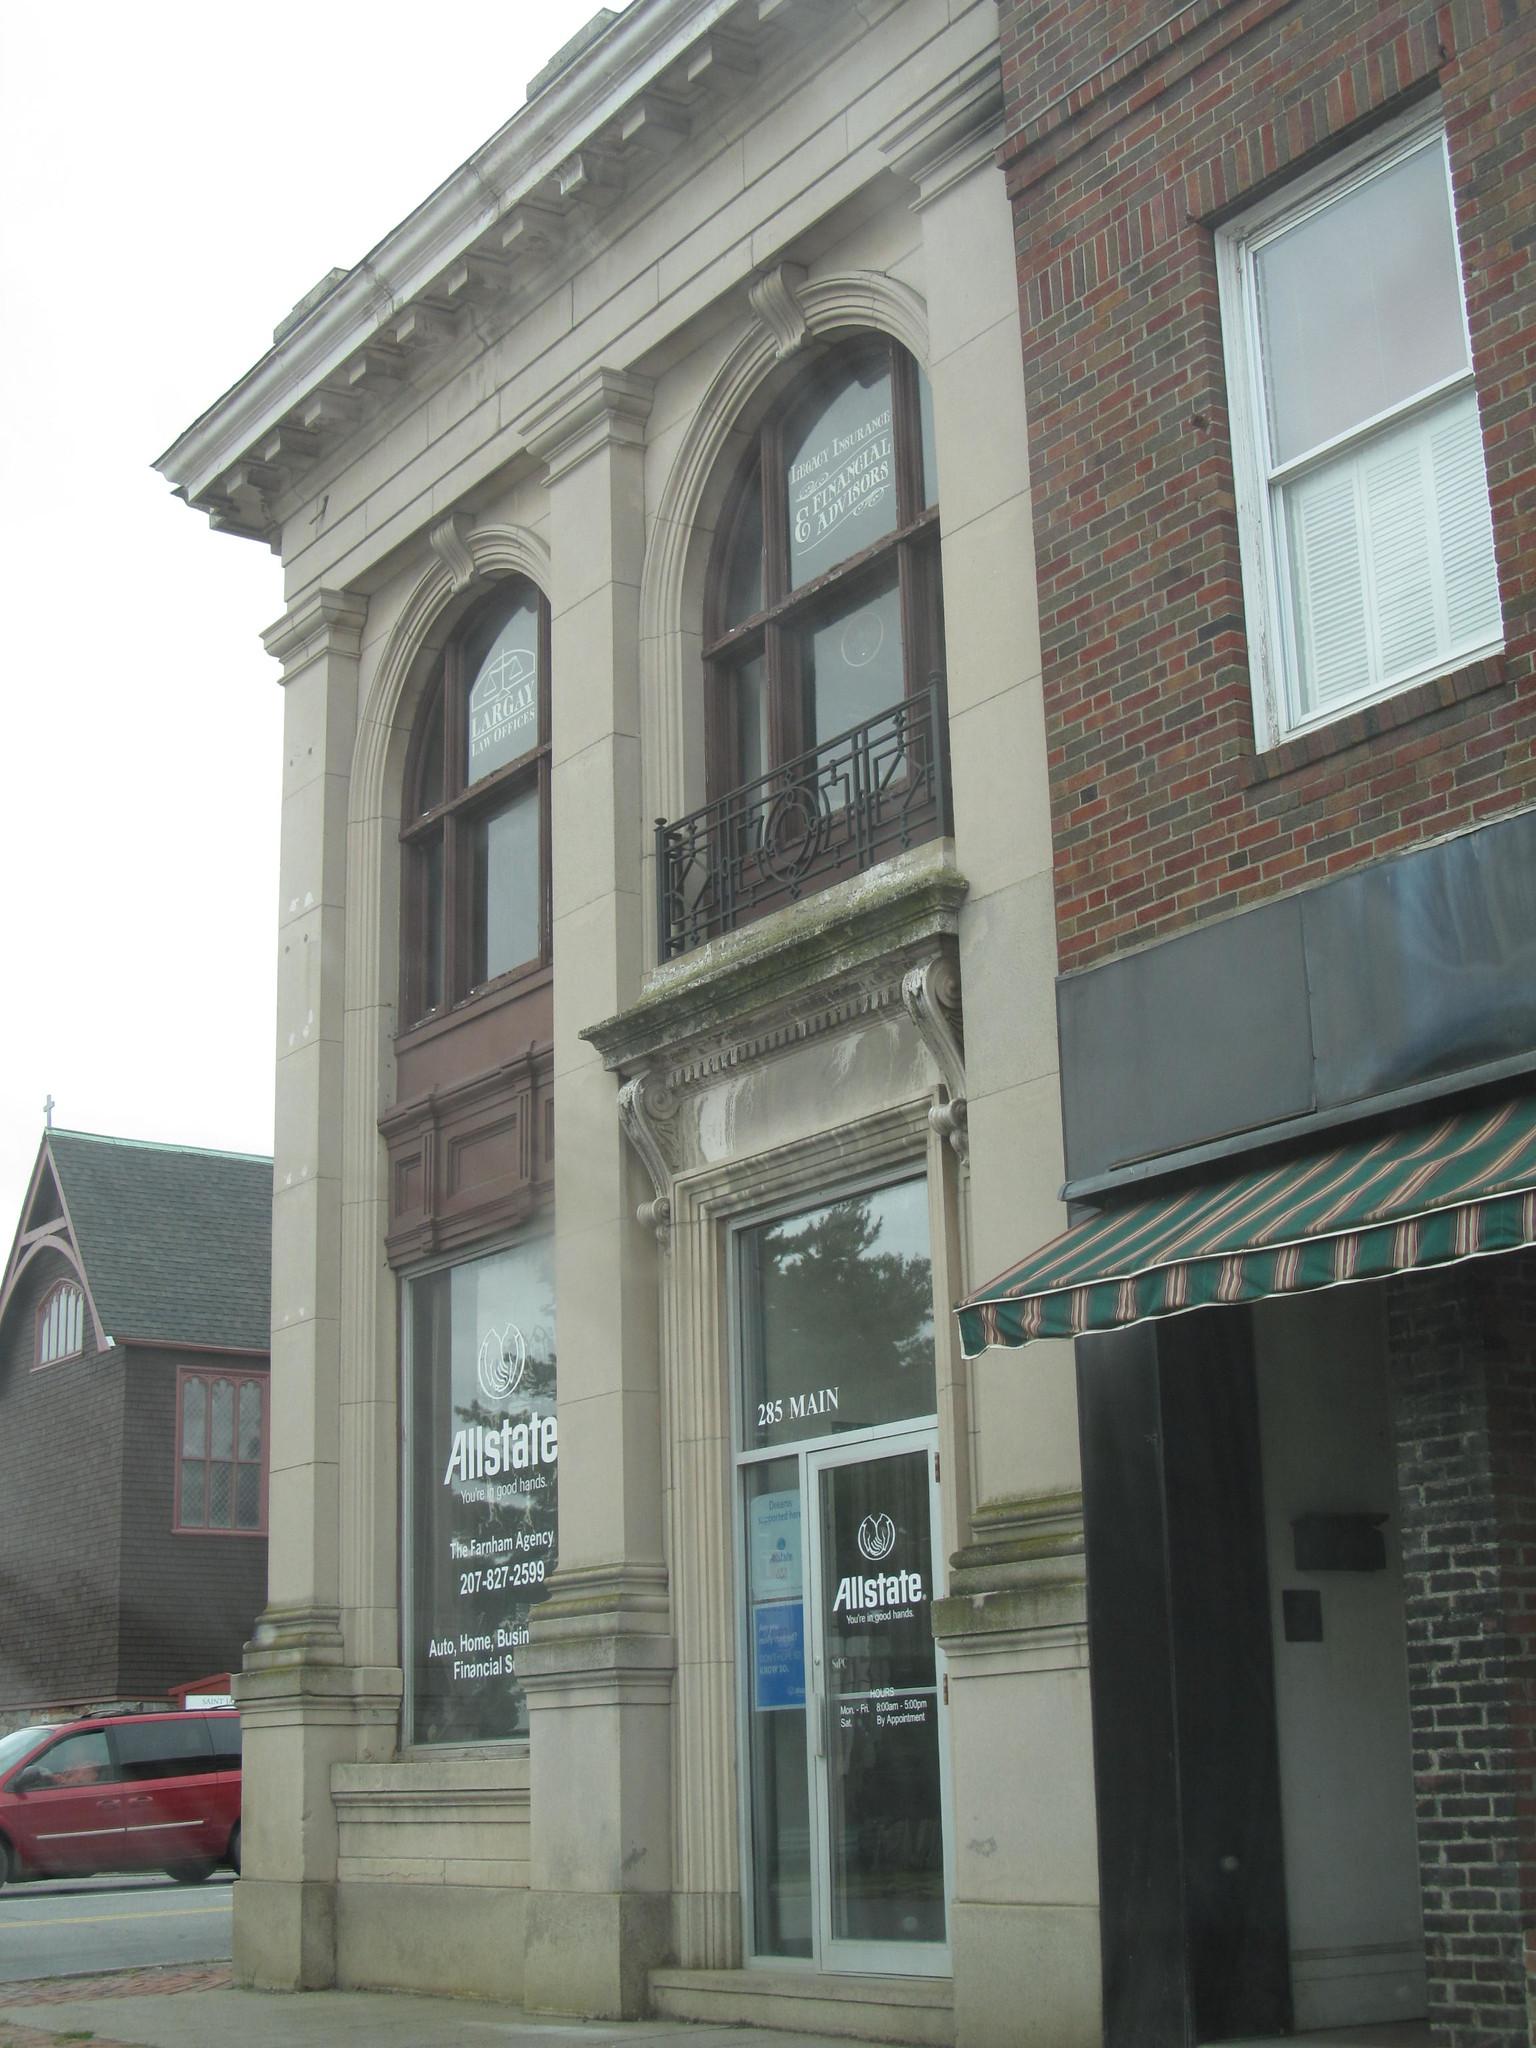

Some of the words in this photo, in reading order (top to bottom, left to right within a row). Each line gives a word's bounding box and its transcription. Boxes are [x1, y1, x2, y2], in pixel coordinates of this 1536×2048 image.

[791, 449, 829, 483] LEGACY
[831, 410, 891, 457] INSURANCE
[813, 438, 891, 515] FINANCIAL
[817, 460, 889, 535] ADVISORS
[471, 679, 535, 739] LARGAY
[472, 737, 491, 757] LAW
[493, 708, 535, 743] OFFICES
[757, 1399, 783, 1427] 285
[789, 1386, 839, 1420] MAIN
[444, 1411, 558, 1486] Allstate
[461, 1487, 485, 1505] You're
[496, 1479, 518, 1500] good
[450, 1541, 468, 1559] The
[470, 1535, 513, 1557] Farnham
[515, 1530, 554, 1552] Agency
[460, 1560, 545, 1595] 207-827-2599
[832, 1569, 922, 1612] Allstate
[846, 1613, 866, 1625] You're
[874, 1610, 892, 1624] good
[428, 1637, 457, 1658] Auto,
[460, 1633, 494, 1653] Home,
[497, 1626, 530, 1648] Busin
[453, 1656, 502, 1680] Financial
[504, 1654, 514, 1674] S
[840, 1705, 855, 1715] Mon.
[876, 1701, 899, 1713] 8:00am
[904, 1699, 928, 1711] 5:00pm
[869, 1686, 895, 1699] HOURS
[876, 1715, 886, 1728] By
[886, 1712, 926, 1727] Appointment
